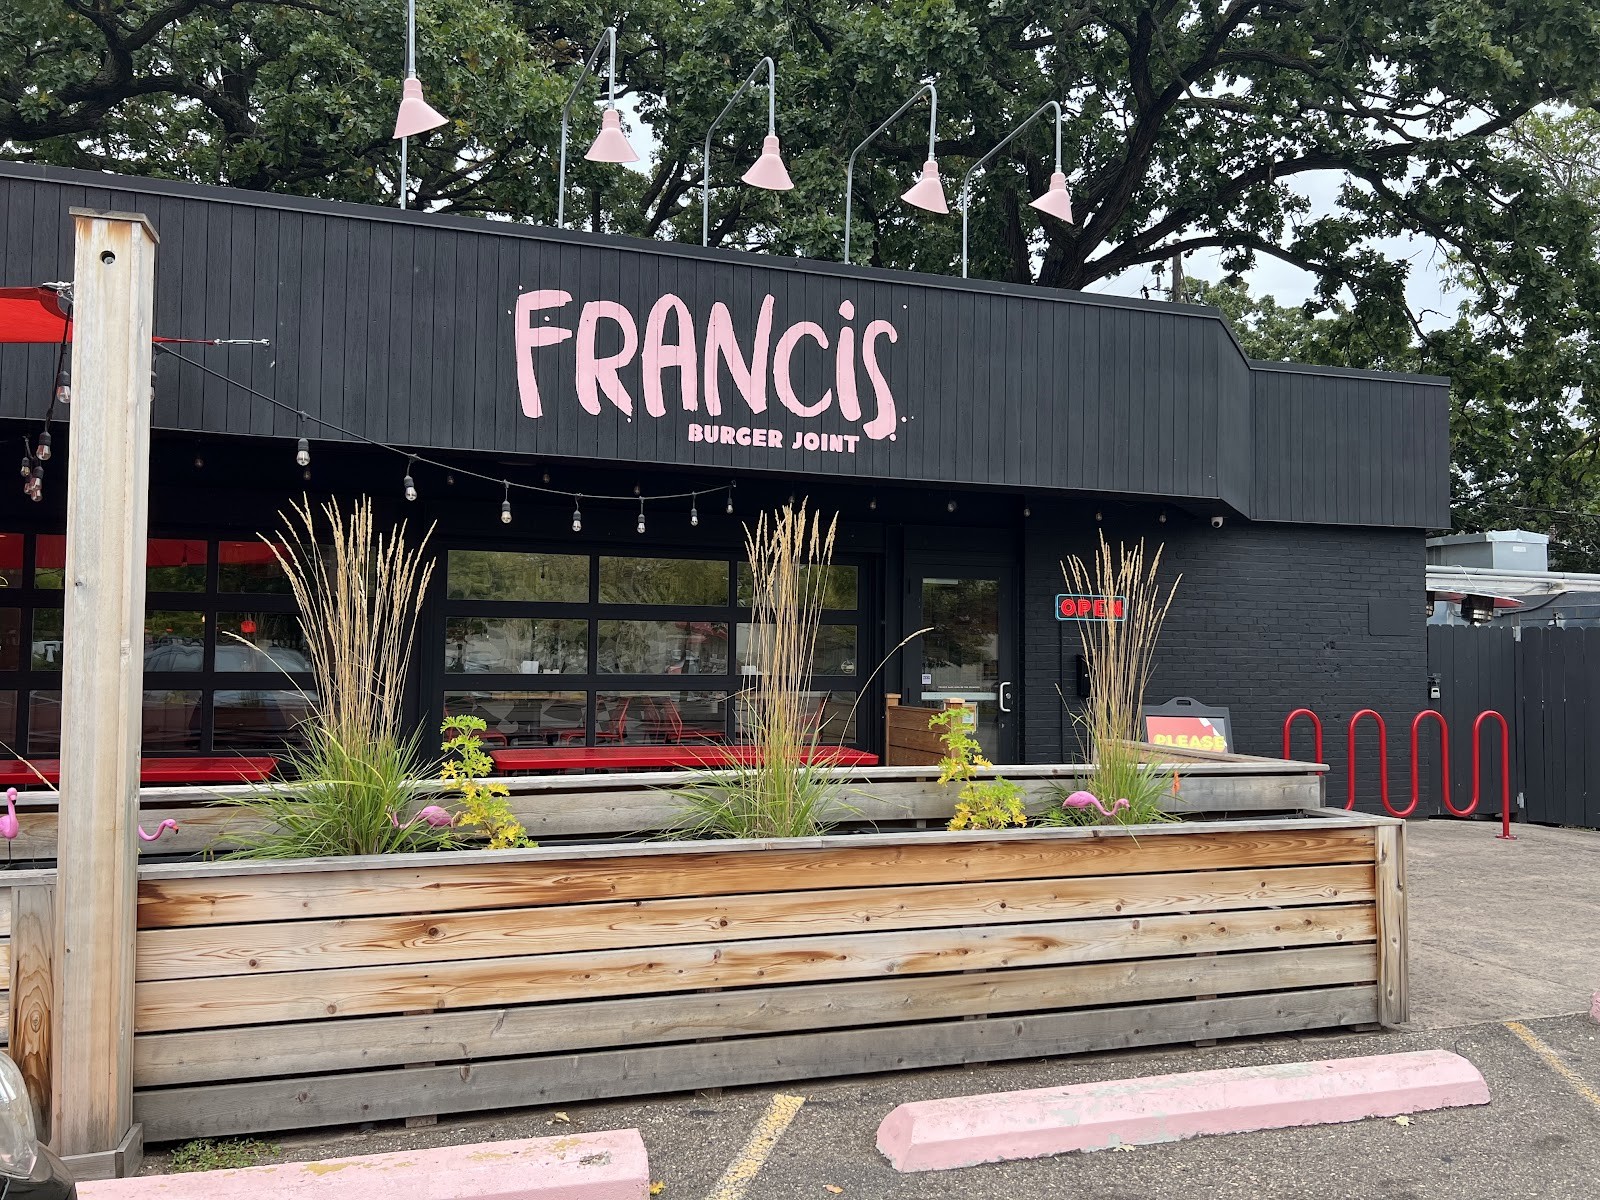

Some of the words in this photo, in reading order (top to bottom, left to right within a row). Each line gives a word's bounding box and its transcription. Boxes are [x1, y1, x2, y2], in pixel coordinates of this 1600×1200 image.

[688, 423, 783, 448] BURGER
[792, 431, 860, 453] JOINT
[1060, 598, 1122, 617] OPEN
[1153, 734, 1225, 750] PLEASE
